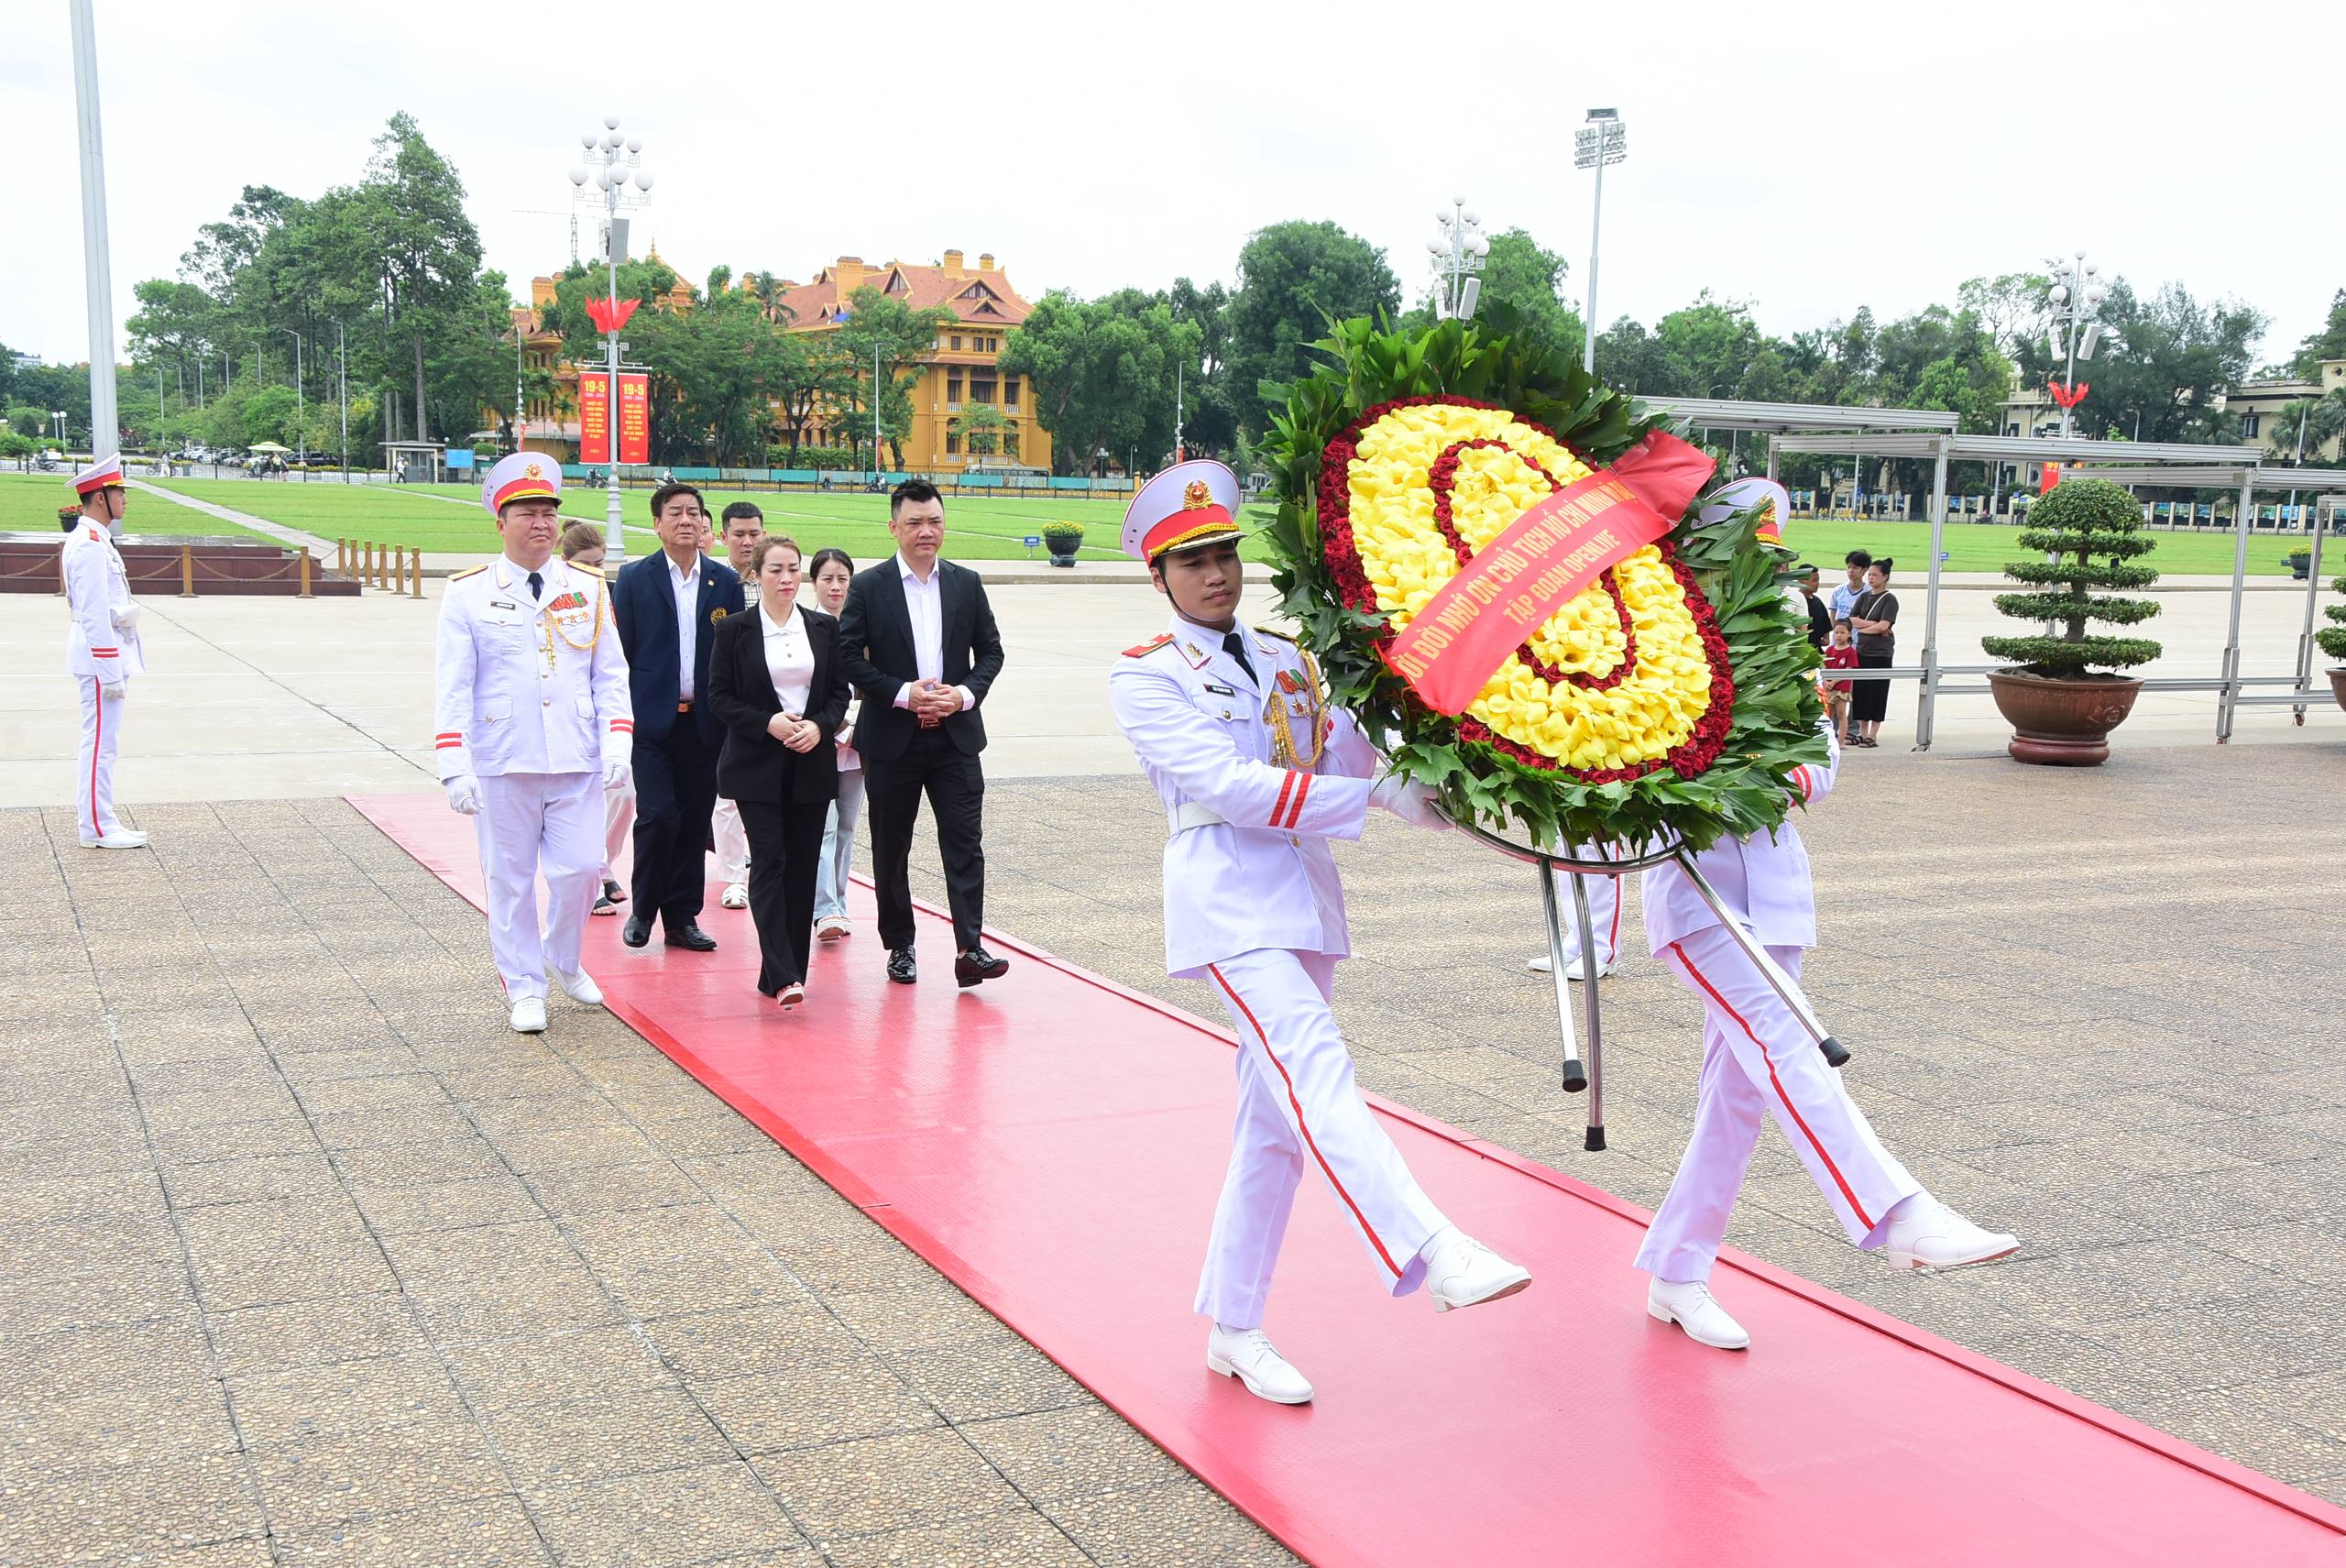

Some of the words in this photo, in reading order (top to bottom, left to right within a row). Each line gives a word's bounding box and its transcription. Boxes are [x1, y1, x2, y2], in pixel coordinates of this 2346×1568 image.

[1390, 652, 1430, 685] ỜI
[1411, 625, 1454, 660] ĐỜI
[1435, 592, 1480, 634] NHỚ
[1466, 575, 1503, 605] ƠN
[1486, 546, 1529, 583] CHỦ
[1512, 526, 1557, 559] TỊCH
[1540, 509, 1572, 540] HỒ
[1556, 499, 1592, 528] CHÍ
[1574, 488, 1617, 516] MINH
[1503, 599, 1537, 625] TẬP
[1529, 565, 1574, 602] ĐOÀN
[1562, 529, 1621, 573] OPENLIVE
